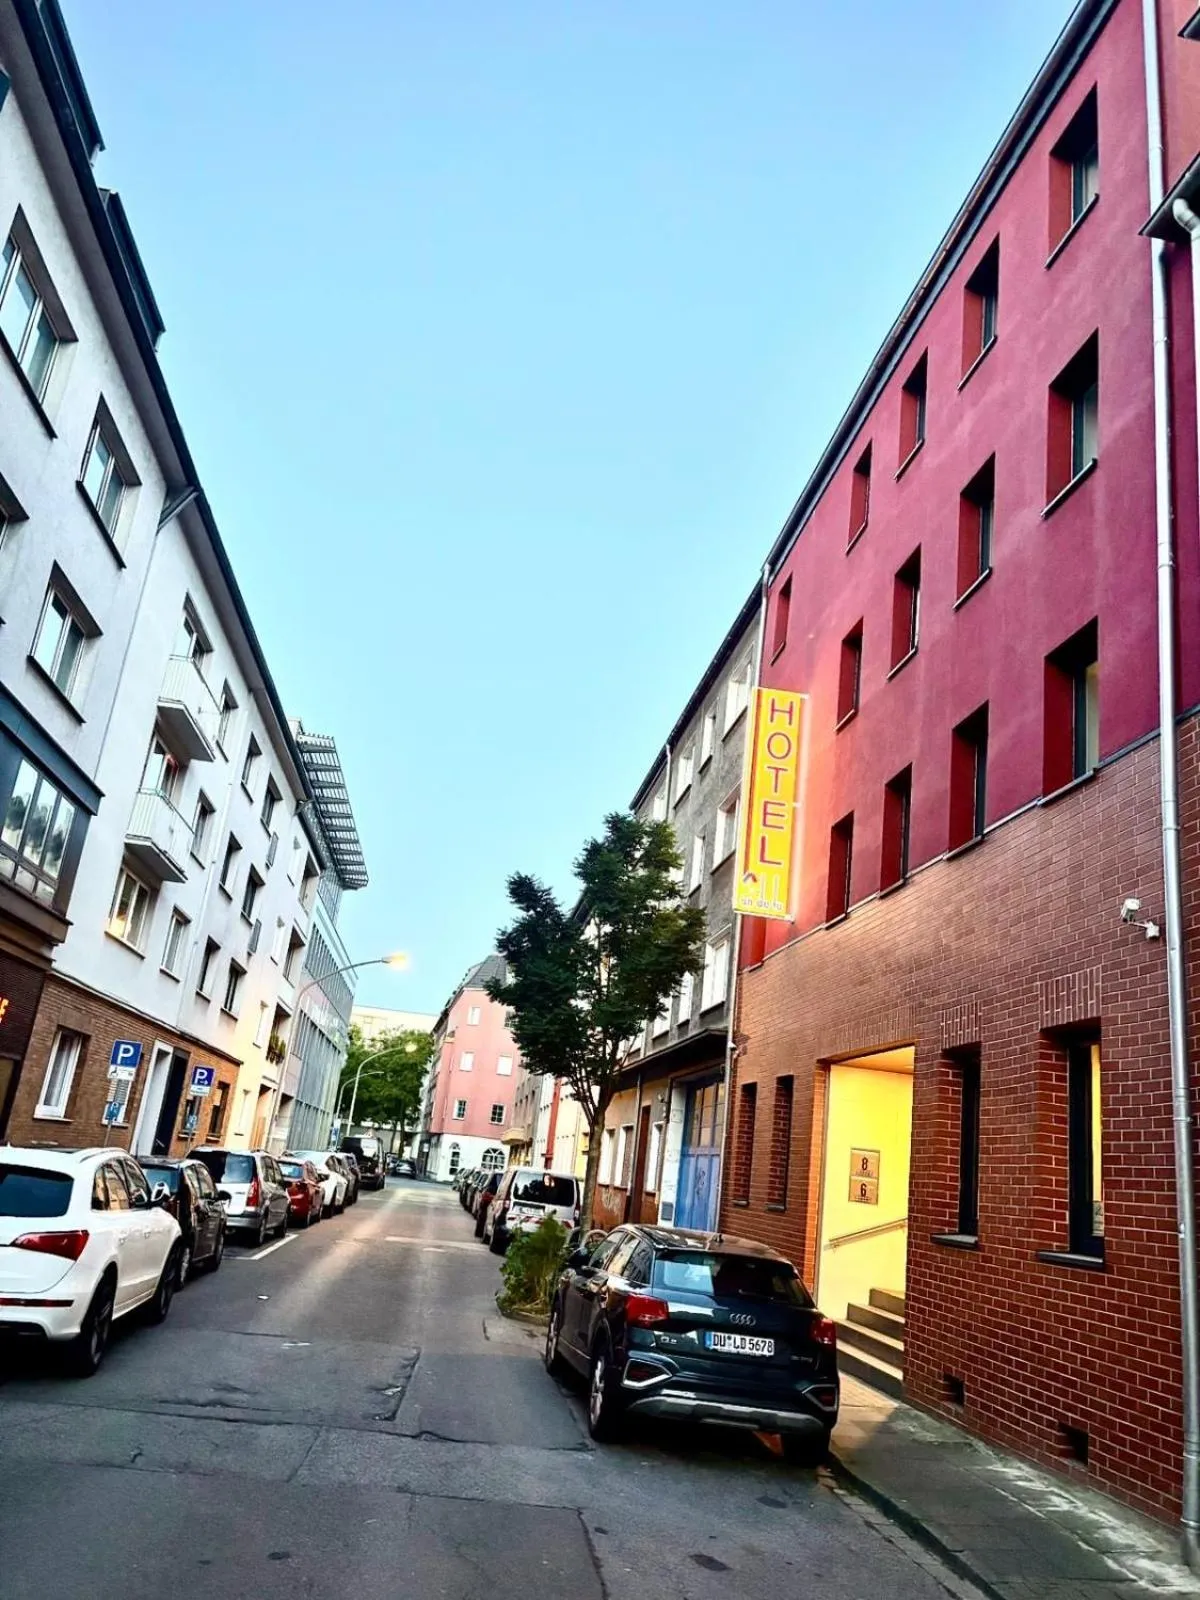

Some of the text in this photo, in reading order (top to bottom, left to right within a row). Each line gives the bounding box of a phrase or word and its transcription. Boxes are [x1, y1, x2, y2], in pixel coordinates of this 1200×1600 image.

[759, 697, 794, 866] HOTEL
[117, 1044, 134, 1065] P
[194, 1068, 208, 1085] P
[862, 1156, 868, 1170] 8
[860, 1183, 867, 1197] 6
[748, 1338, 773, 1354] 5678
